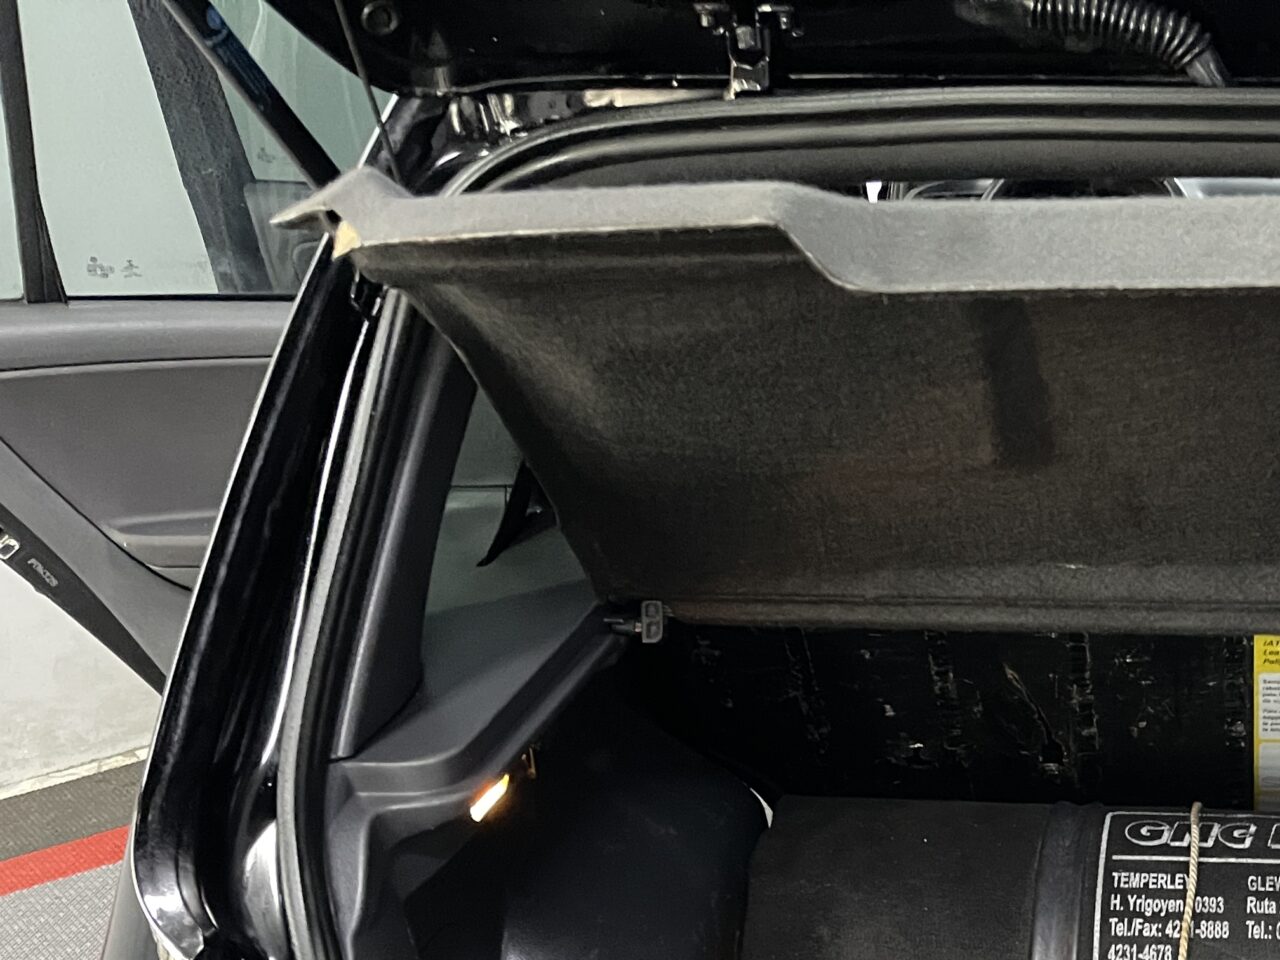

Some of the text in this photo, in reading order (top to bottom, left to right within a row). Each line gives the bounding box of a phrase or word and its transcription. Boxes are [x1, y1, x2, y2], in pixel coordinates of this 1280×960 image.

[1124, 820, 1257, 850] GNC
[1110, 894, 1225, 917] H. Yrigoyen 0393
[1246, 896, 1277, 914] Ruta
[1108, 918, 1230, 939] Tel./Fax: 421-8888
[1245, 920, 1272, 940] Tel.:
